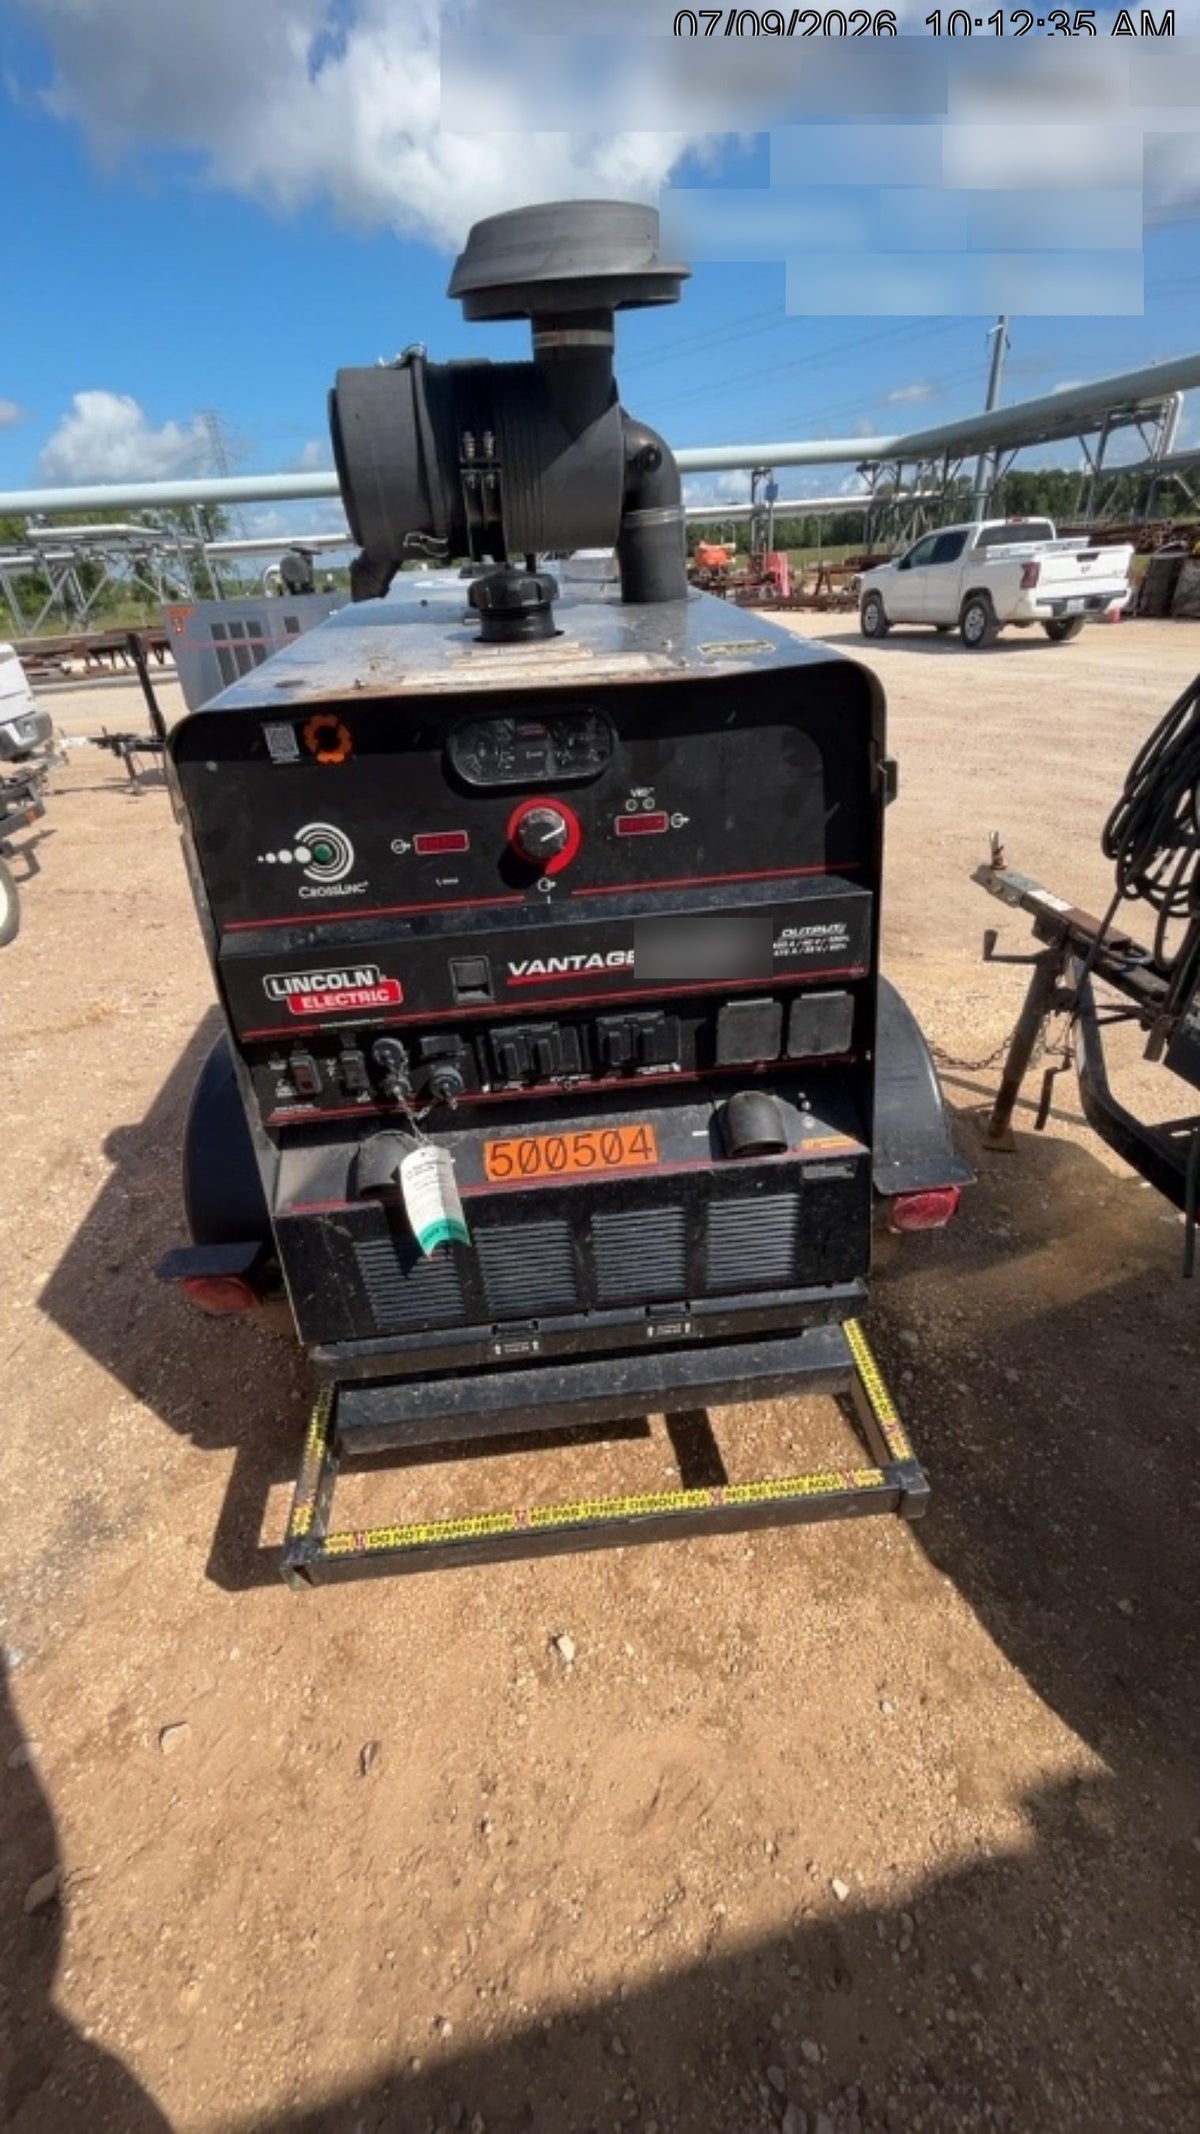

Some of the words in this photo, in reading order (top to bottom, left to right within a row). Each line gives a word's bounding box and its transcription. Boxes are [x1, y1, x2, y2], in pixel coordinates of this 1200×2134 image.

[271, 969, 374, 995] LINCOLN
[301, 988, 390, 1009] ELECTRIC
[489, 1127, 653, 1177] 500504
